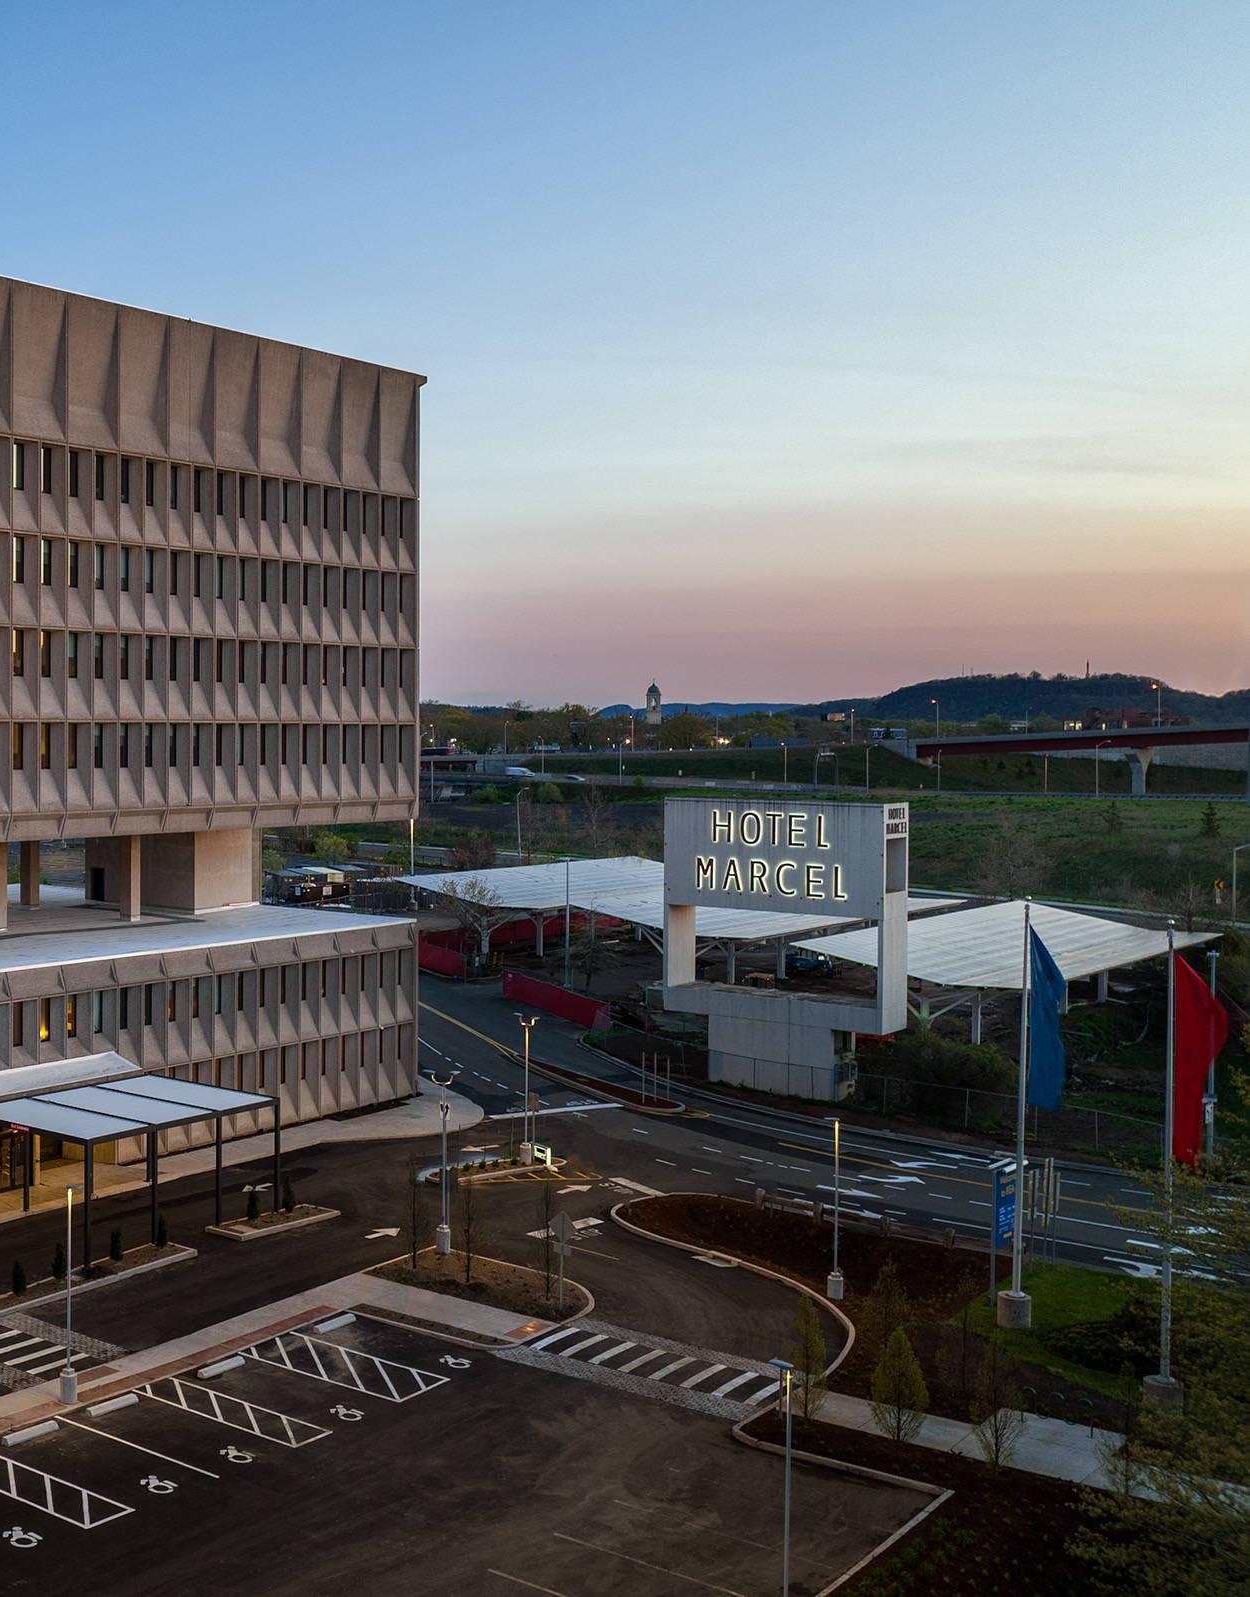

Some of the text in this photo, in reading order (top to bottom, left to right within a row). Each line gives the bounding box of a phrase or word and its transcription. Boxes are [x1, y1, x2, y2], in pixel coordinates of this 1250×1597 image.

[888, 807, 906, 820] HOTEL
[712, 809, 830, 849] HOTEL
[695, 857, 847, 901] MARCEL
[598, 1182, 634, 1195] STOP
[570, 1229, 603, 1241] STOP
